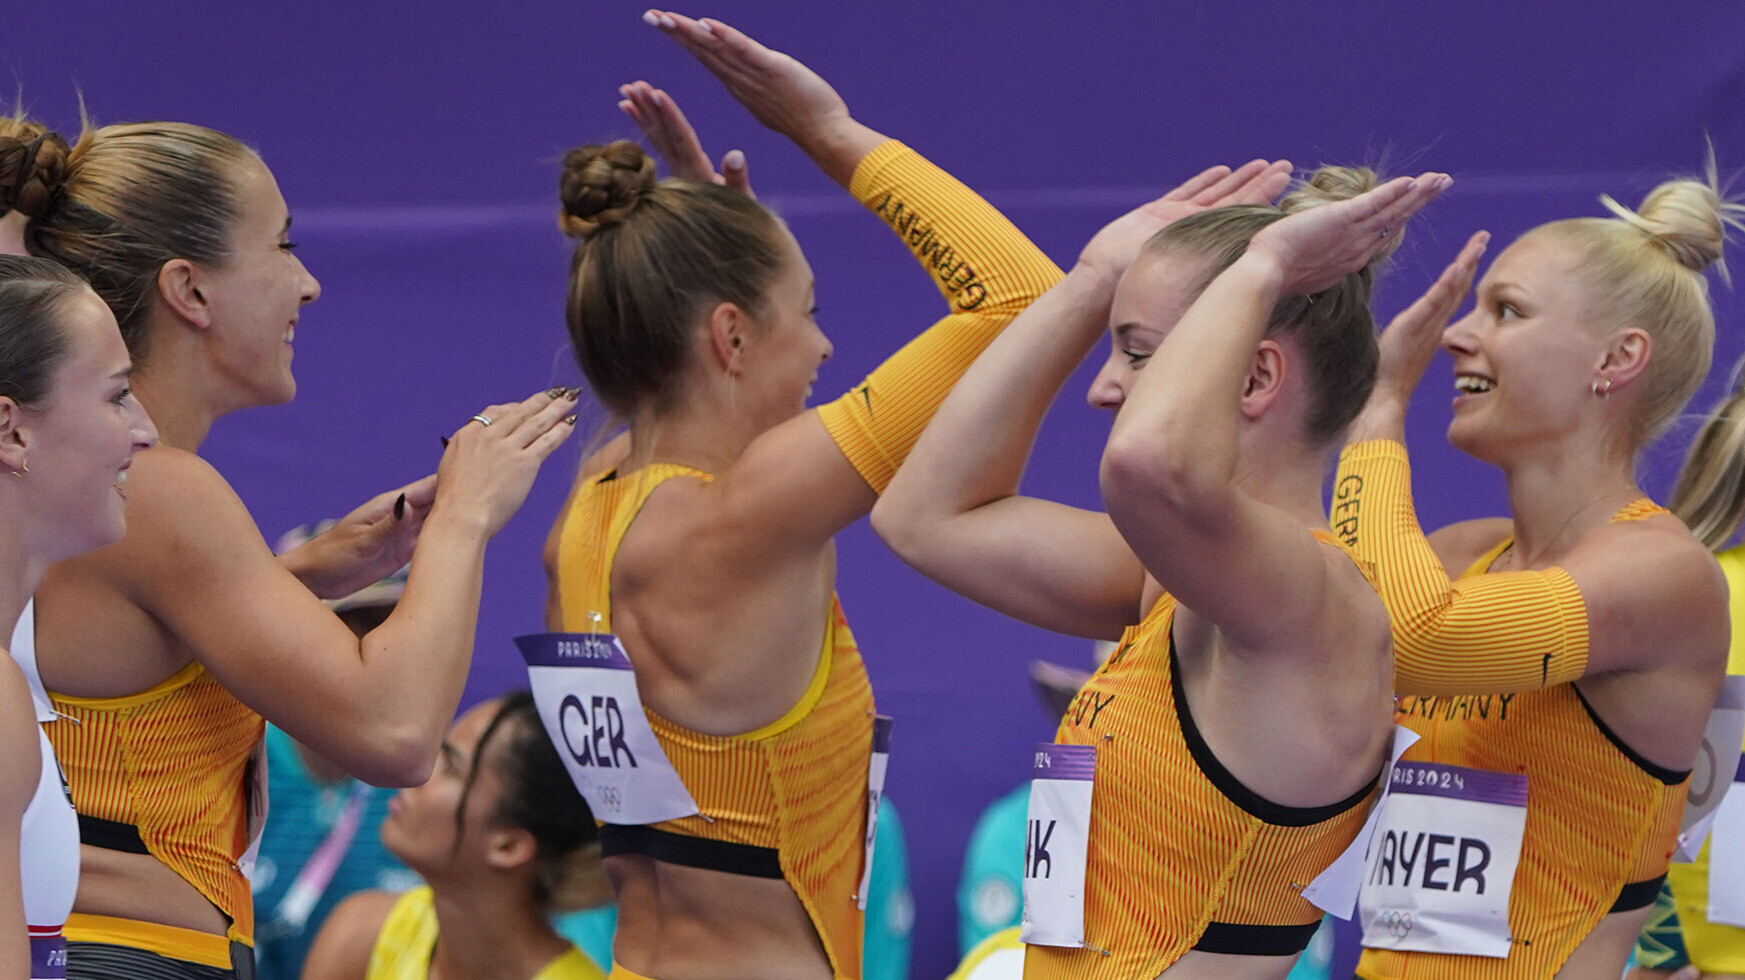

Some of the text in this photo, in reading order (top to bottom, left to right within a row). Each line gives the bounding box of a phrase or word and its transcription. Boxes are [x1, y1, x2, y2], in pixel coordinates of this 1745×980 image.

[876, 193, 987, 311] GERMANY
[558, 693, 639, 769] GER
[1415, 768, 1465, 791] 2024
